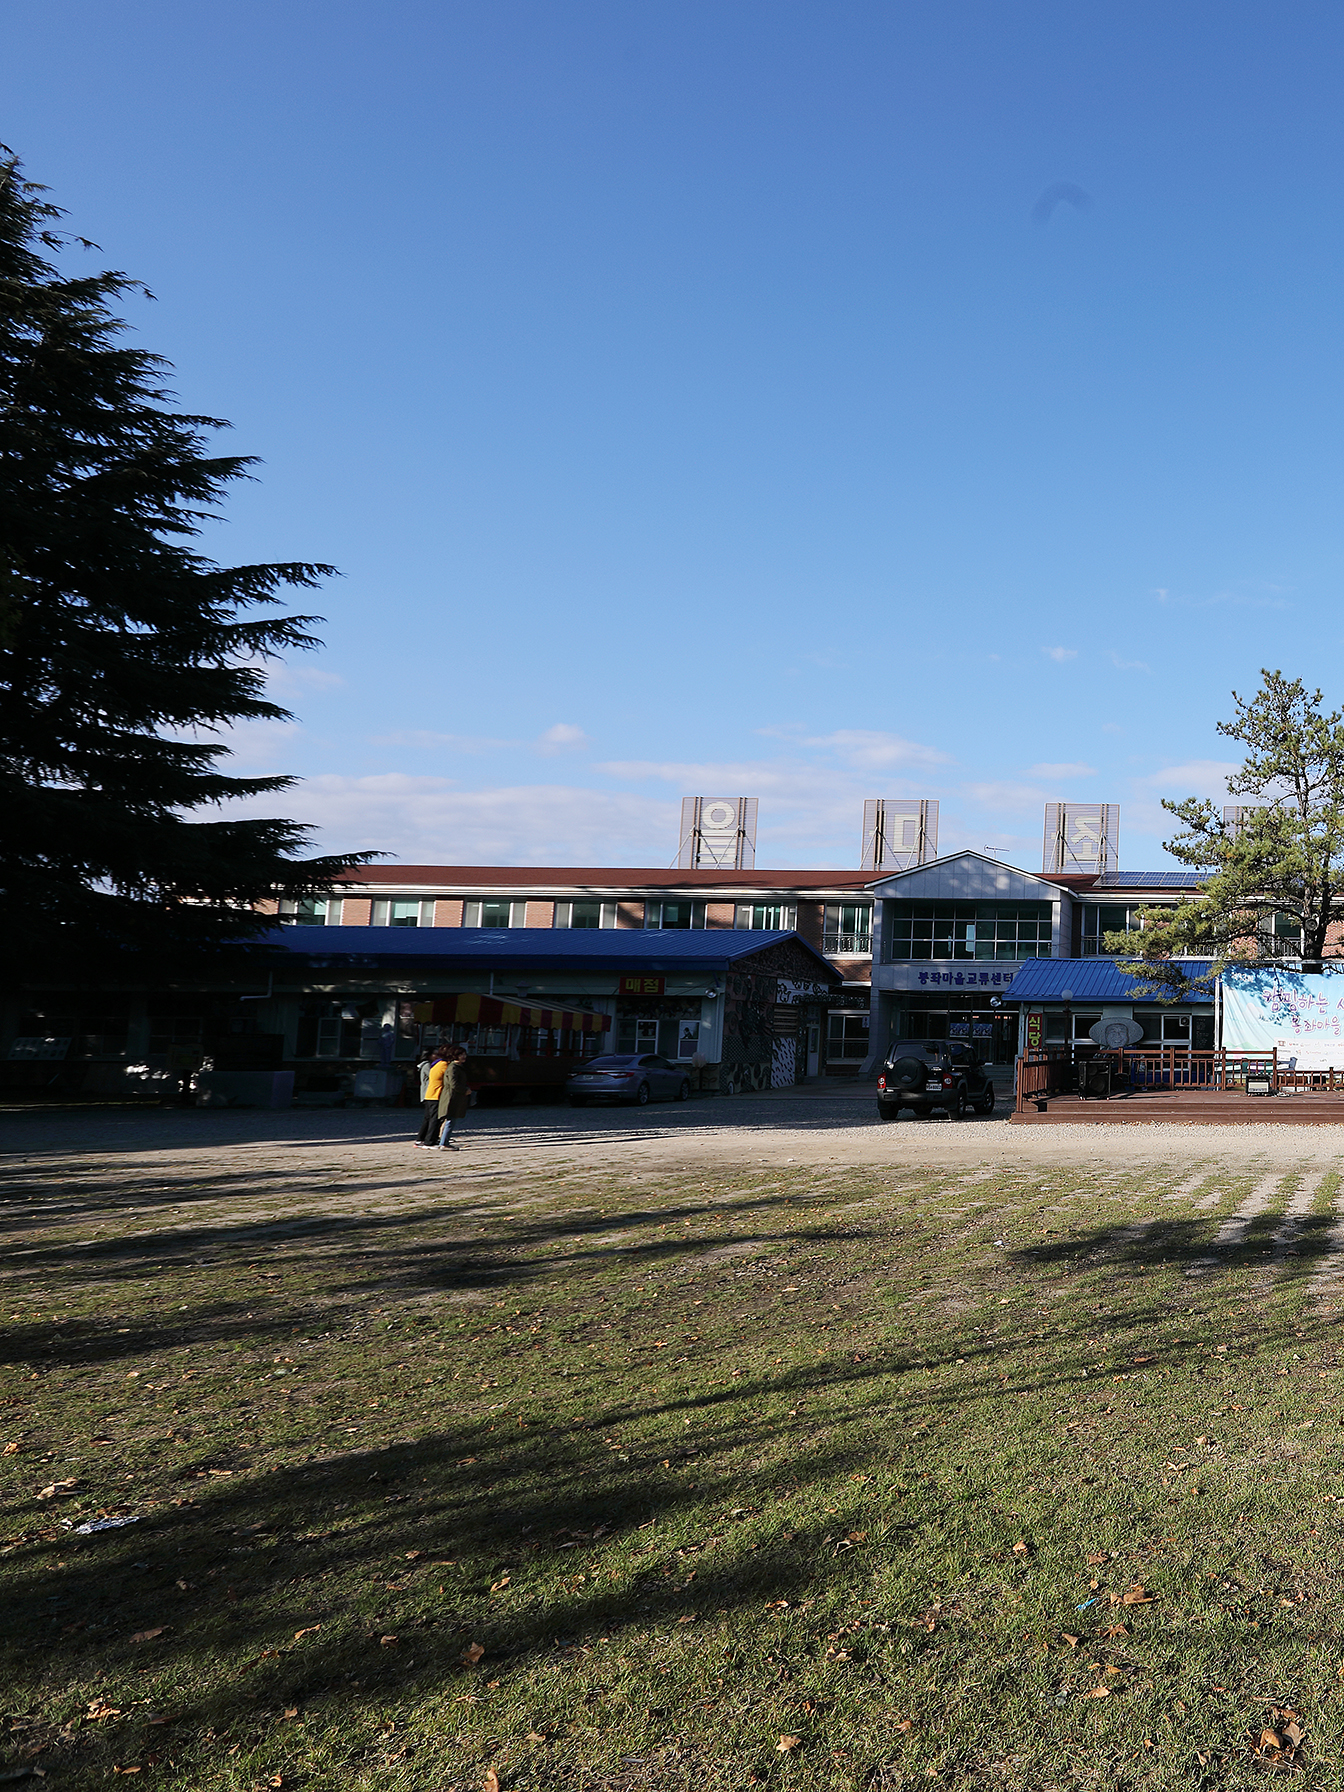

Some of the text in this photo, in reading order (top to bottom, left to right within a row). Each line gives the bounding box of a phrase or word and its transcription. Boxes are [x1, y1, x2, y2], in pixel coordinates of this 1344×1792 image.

[624, 978, 660, 994] 매점
[917, 971, 1014, 986] 봉좌마을교류센터
[1262, 985, 1330, 1014] 캠핑하는
[1028, 1016, 1041, 1047] 식당
